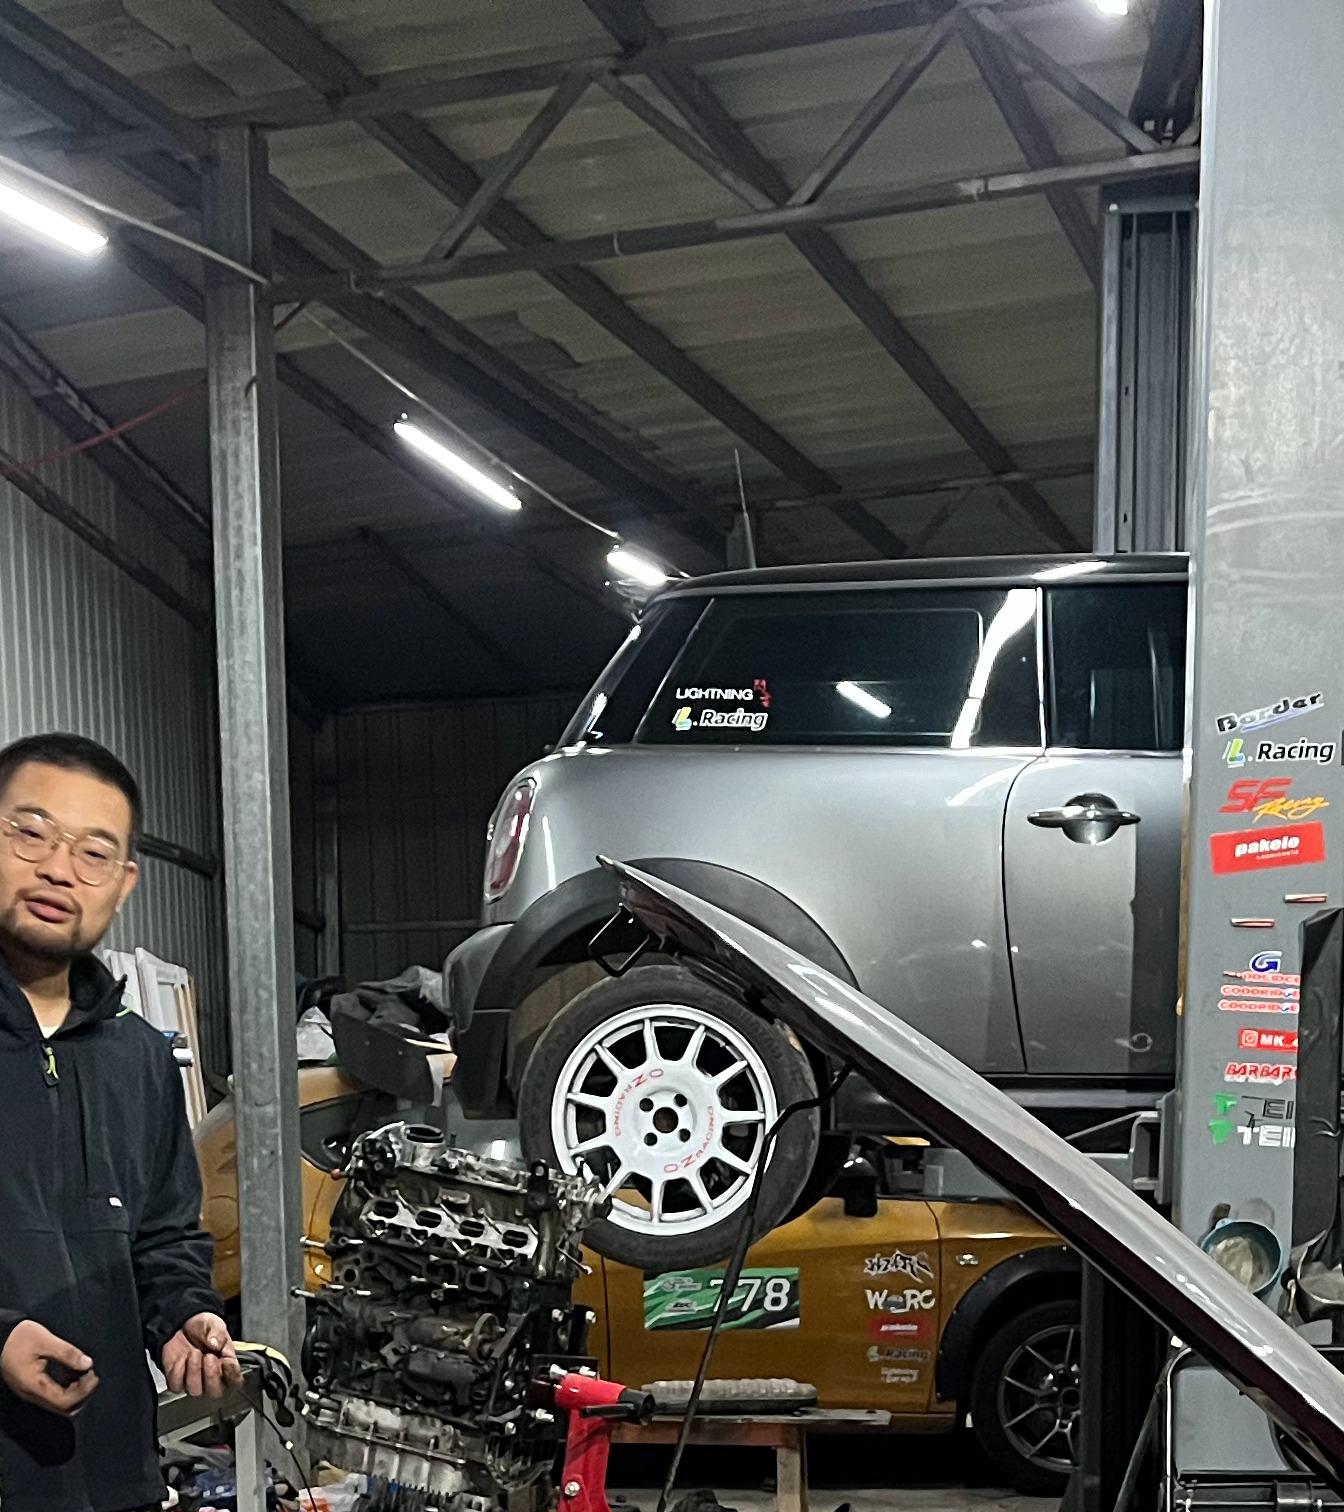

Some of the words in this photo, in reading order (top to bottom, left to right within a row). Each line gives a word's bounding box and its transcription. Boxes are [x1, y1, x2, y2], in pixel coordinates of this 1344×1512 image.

[676, 687, 754, 700] LIGHTNING
[699, 707, 768, 731] Racing
[1257, 737, 1336, 765] Racing
[1225, 1063, 1296, 1080] BARBAR
[710, 1277, 791, 1312] 778
